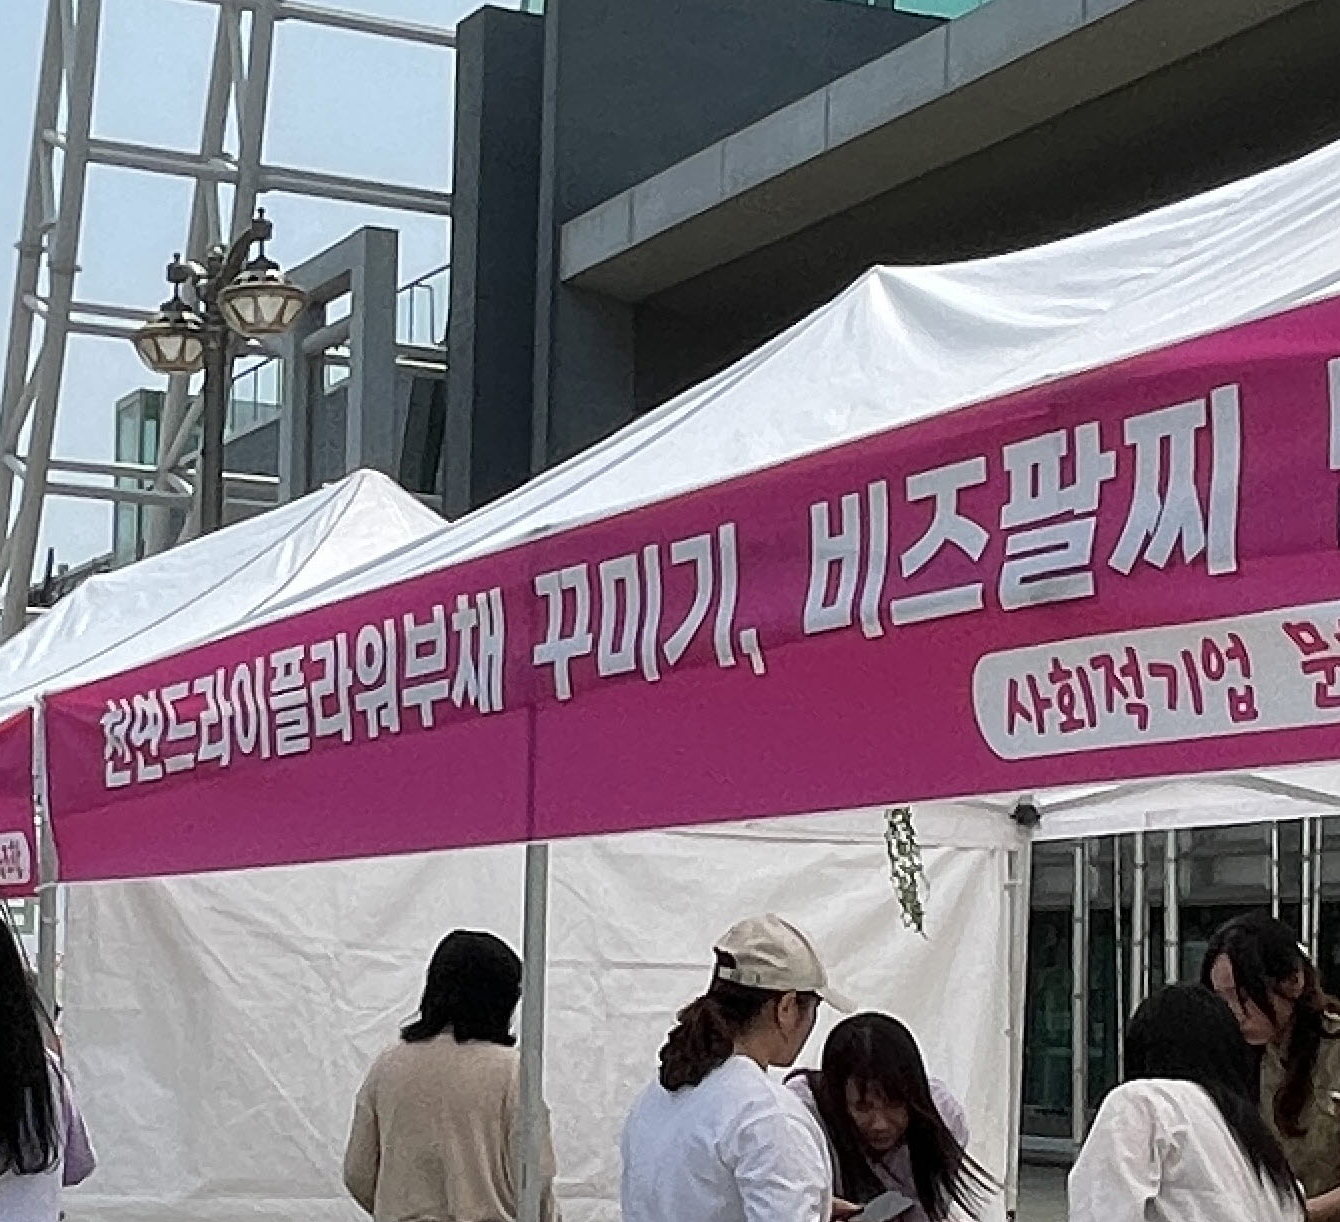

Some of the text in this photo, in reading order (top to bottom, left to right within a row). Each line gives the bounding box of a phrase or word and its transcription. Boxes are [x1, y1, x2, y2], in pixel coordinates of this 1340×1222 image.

[100, 587, 505, 788] 천연드라이플라워부채
[533, 523, 765, 675] 꾸미기,
[803, 398, 1239, 637] 비즈팔찌
[1008, 634, 1259, 735] 사회적기업
